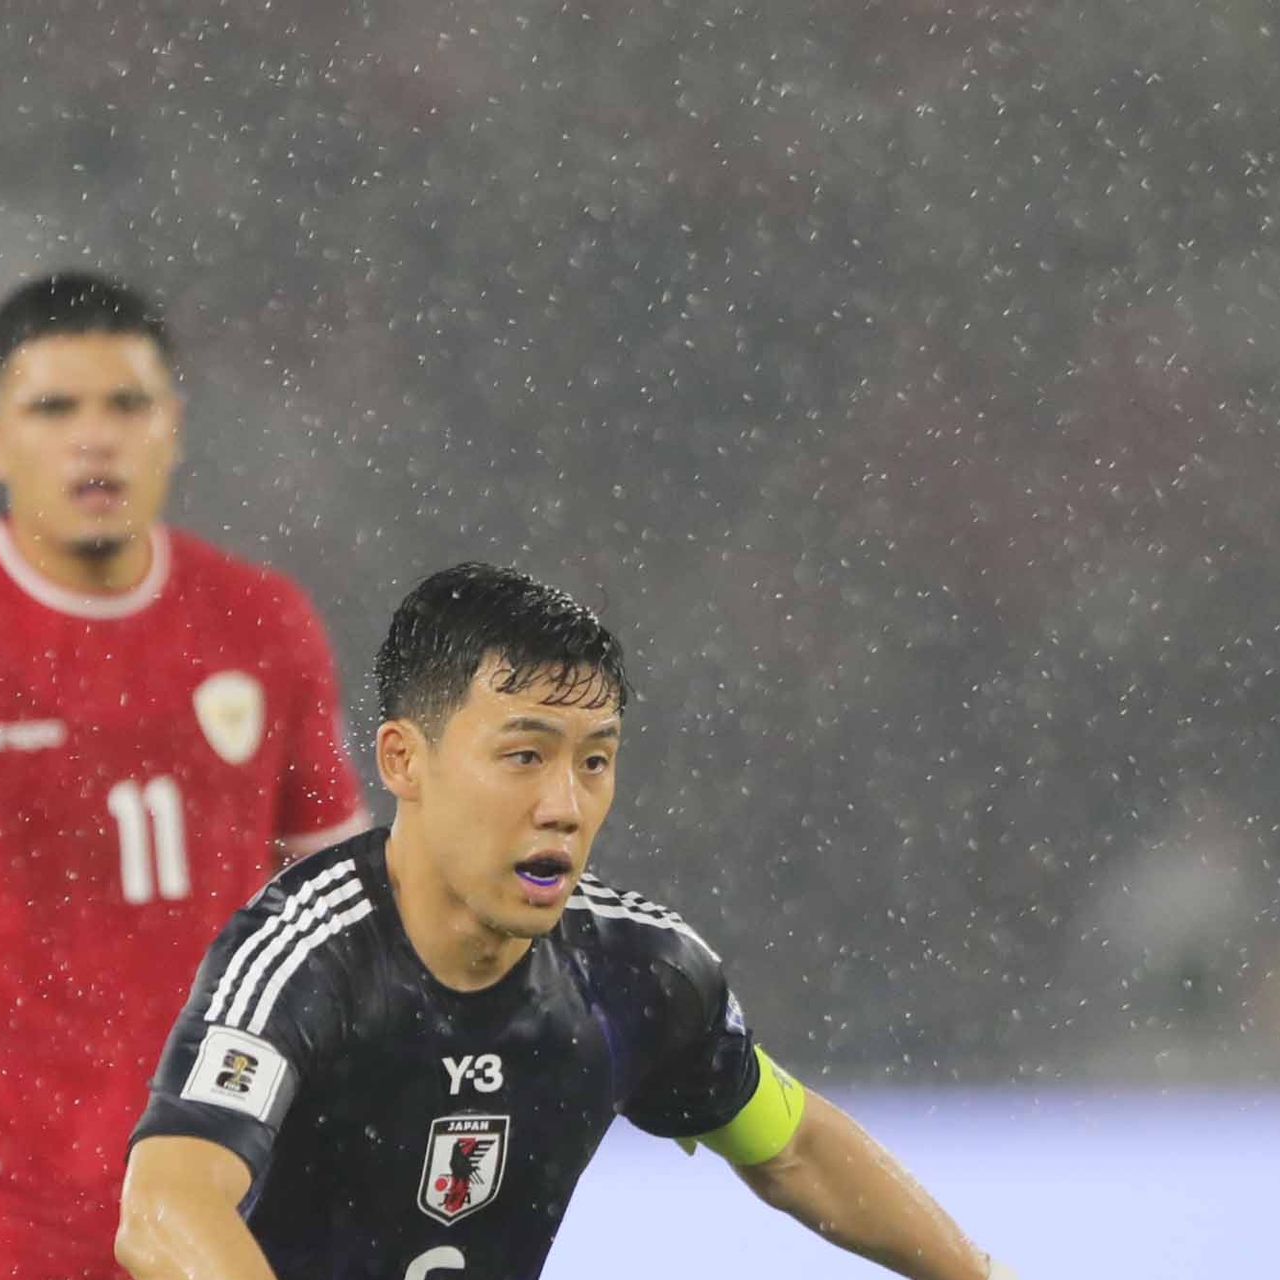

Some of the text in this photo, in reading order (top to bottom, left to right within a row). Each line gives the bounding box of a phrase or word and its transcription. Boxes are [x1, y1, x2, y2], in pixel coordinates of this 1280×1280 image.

[107, 773, 190, 904] 11
[441, 1054, 504, 1095] Y-3
[447, 1121, 489, 1132] JAPAN
